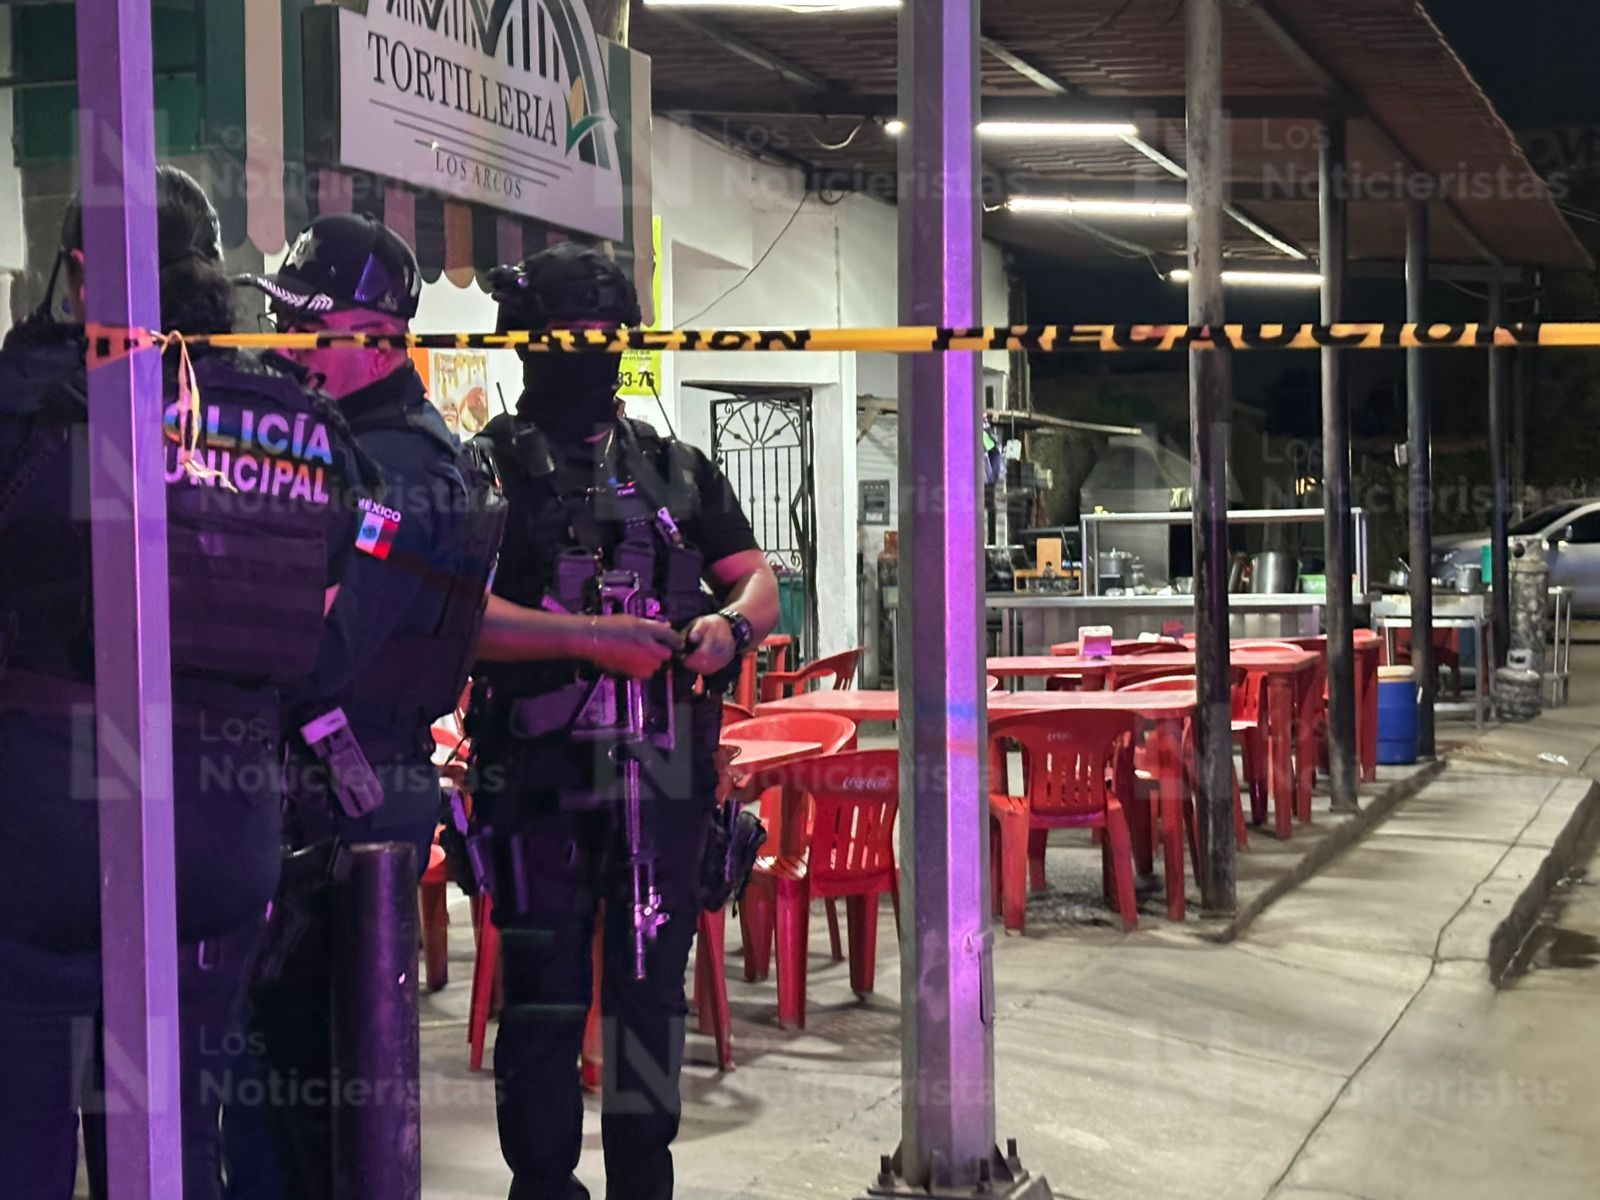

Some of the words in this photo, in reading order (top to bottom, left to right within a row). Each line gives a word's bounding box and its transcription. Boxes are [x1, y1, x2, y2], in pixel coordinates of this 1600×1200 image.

[368, 31, 557, 147] TORTILLERIA
[434, 151, 467, 181] LOS
[473, 163, 522, 199] ARCOS
[163, 401, 332, 464] OLICÍA
[164, 446, 330, 504] UNICIPAL
